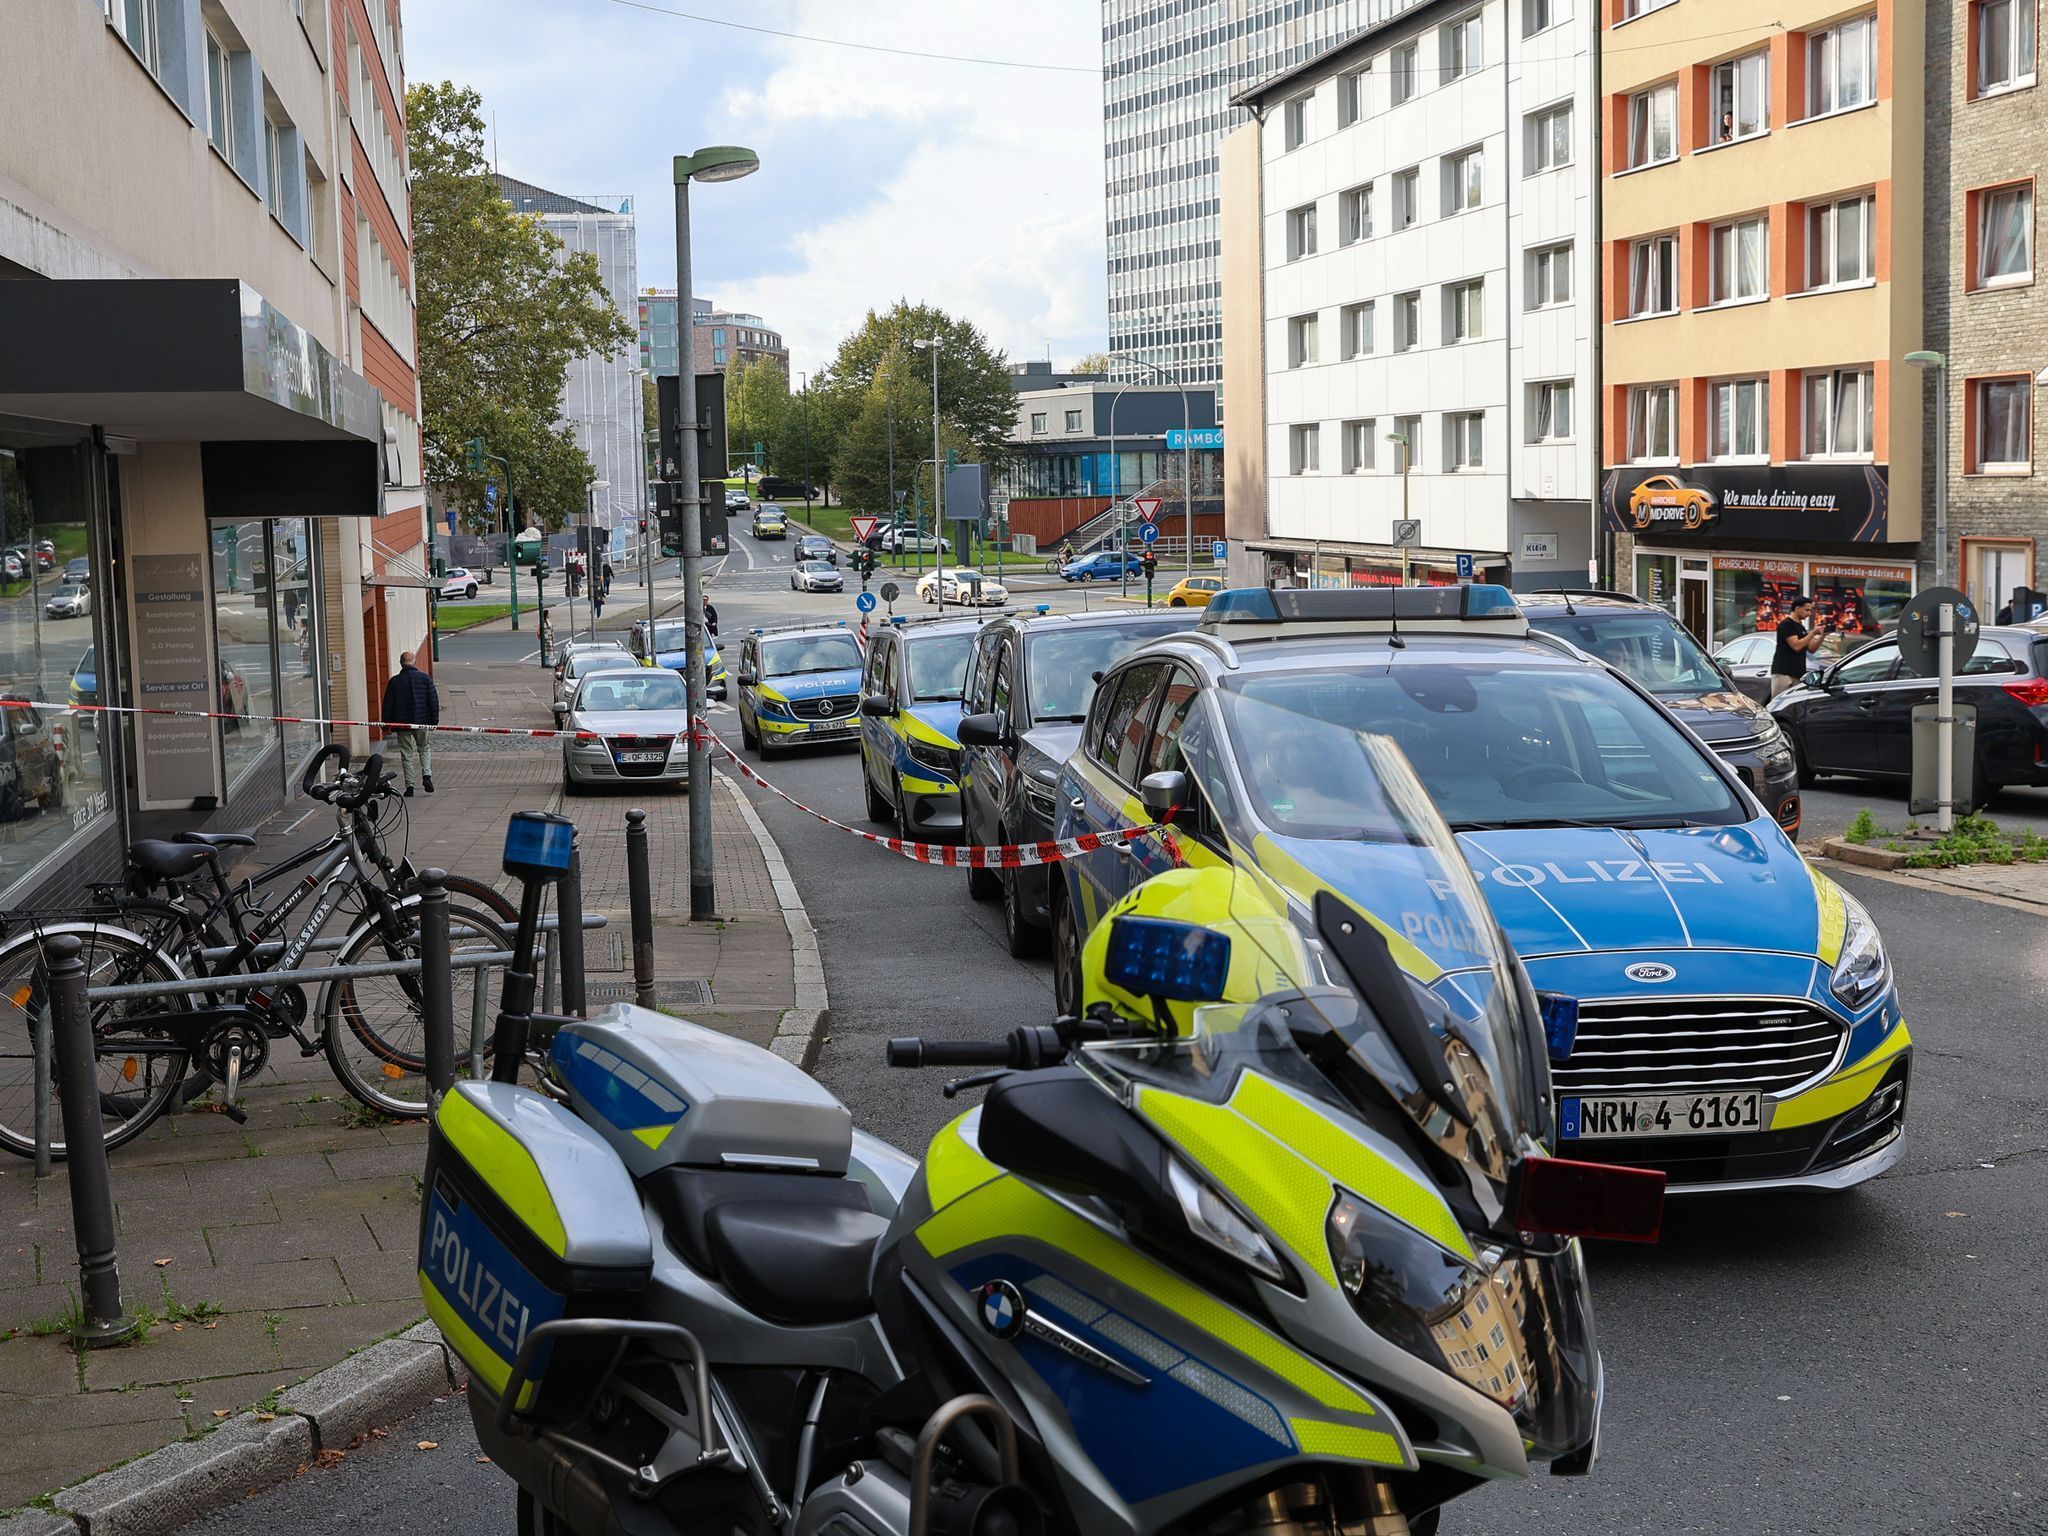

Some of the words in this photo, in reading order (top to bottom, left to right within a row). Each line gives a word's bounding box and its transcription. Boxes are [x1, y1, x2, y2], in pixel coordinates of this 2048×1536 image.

[1723, 489, 1738, 505] We
[1740, 489, 1765, 506] make
[1769, 489, 1808, 512] driving
[1809, 495, 1836, 512] easy
[1650, 507, 1686, 520] MD-DRIVE
[1460, 557, 1468, 575] P
[1719, 558, 1760, 570] FAHRSCHULE
[1763, 561, 1799, 573] MD-DRIVE
[148, 593, 192, 601] Gestaltung
[165, 642, 194, 650] Planung
[146, 684, 175, 692] Service
[795, 679, 847, 689] POLIZEI
[160, 701, 192, 709] Beratung
[644, 752, 663, 761] 3325
[73, 805, 87, 831] since
[94, 790, 107, 814] Years
[1426, 860, 1724, 900] POLIZEI
[270, 888, 304, 925] ALICANTE
[1580, 1102, 1638, 1133] NRW
[1566, 1123, 1575, 1131] D
[430, 1210, 530, 1357] POLIZEI
